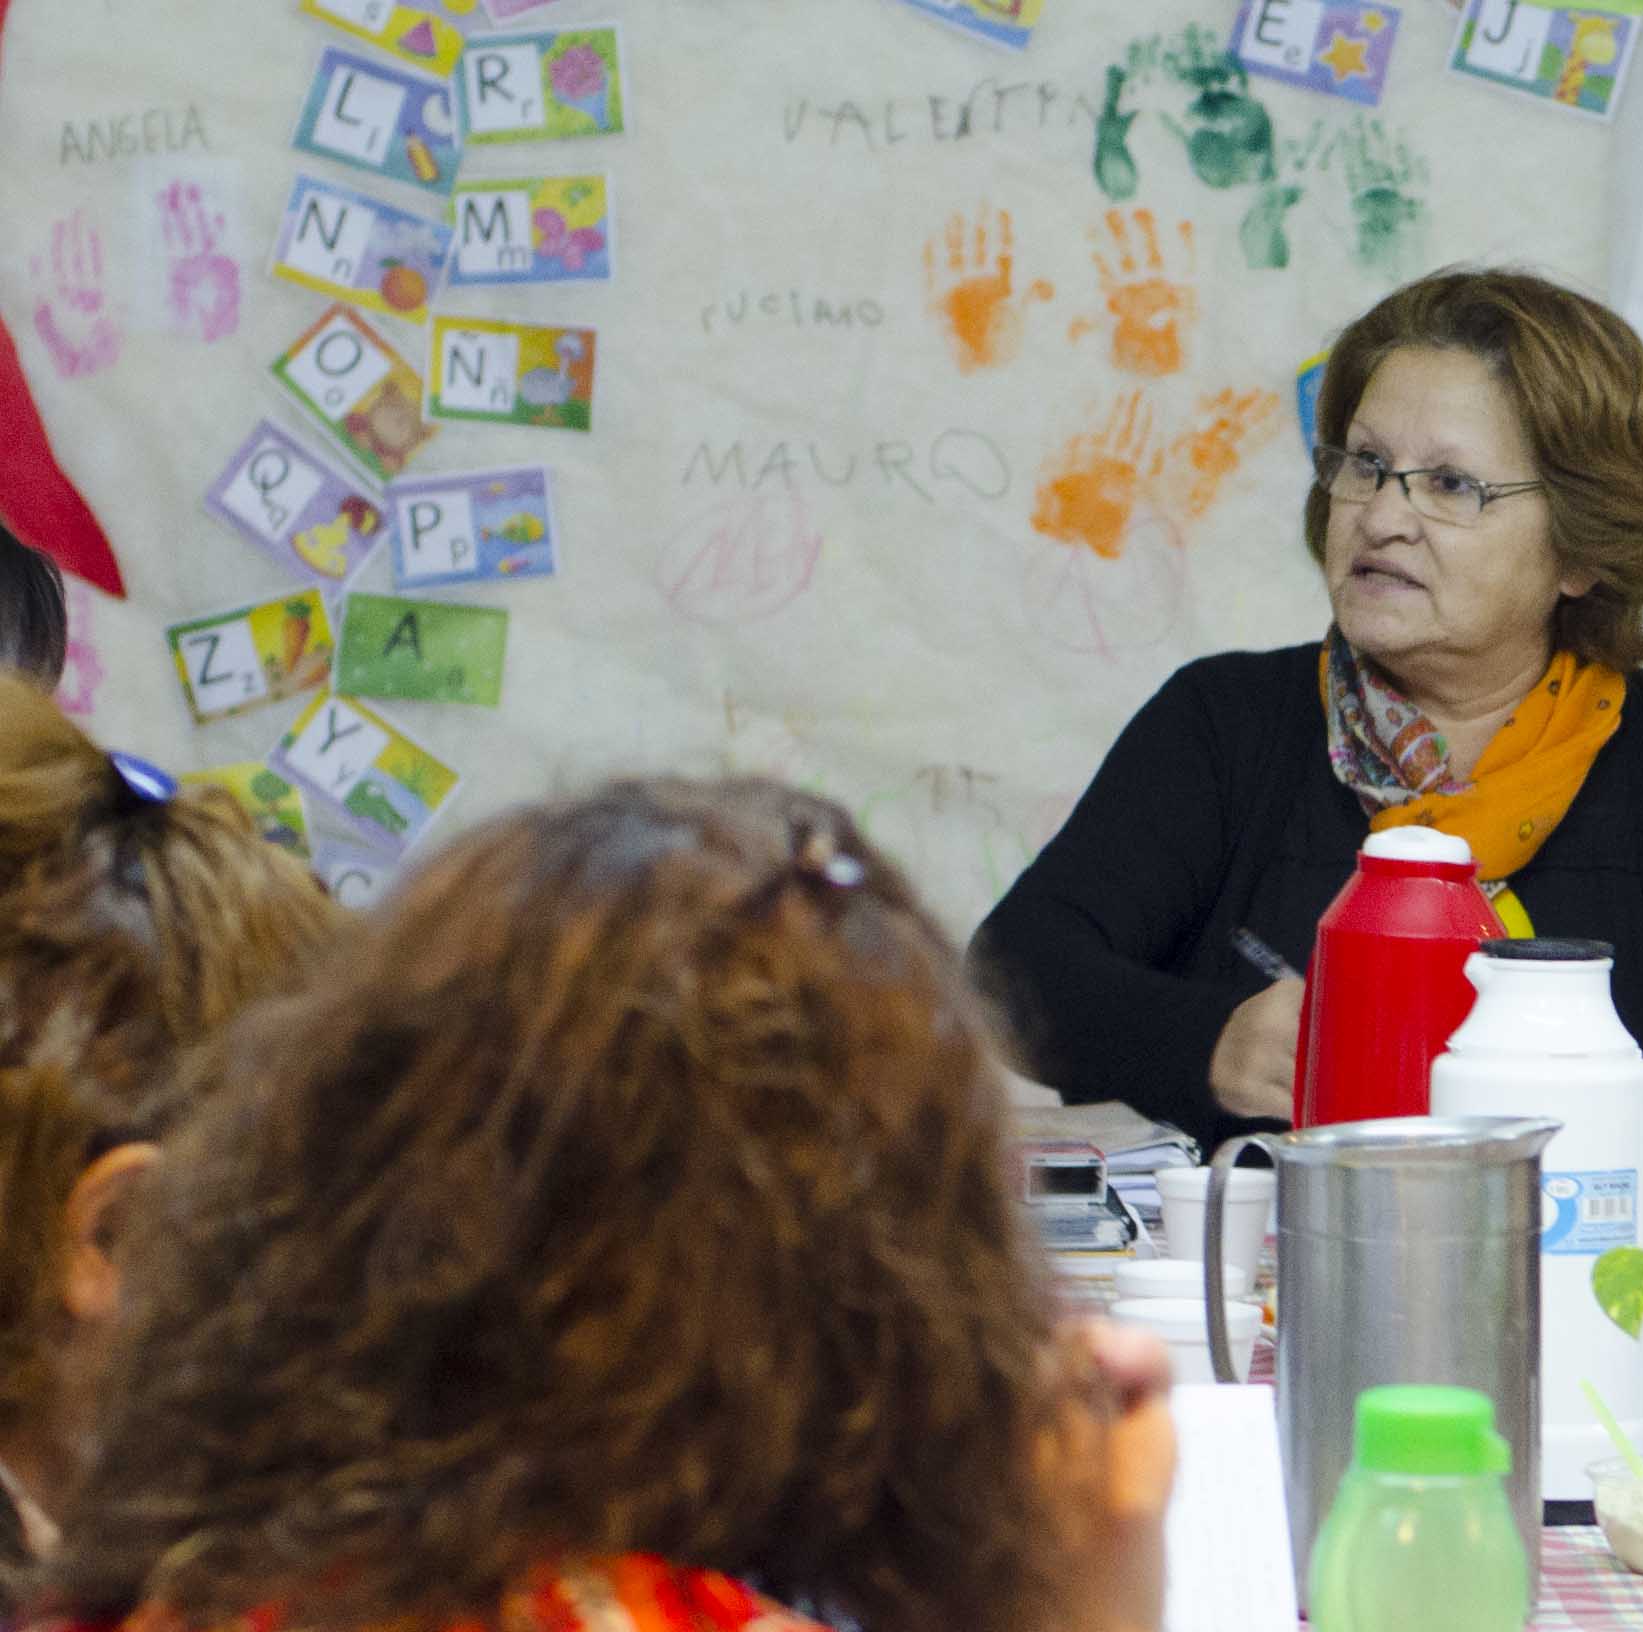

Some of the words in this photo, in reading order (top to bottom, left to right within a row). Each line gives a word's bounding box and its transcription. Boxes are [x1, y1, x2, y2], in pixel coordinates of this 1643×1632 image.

[336, 72, 362, 127] L
[476, 54, 515, 104] R
[297, 197, 350, 252] N
[462, 196, 513, 248] M
[314, 329, 364, 378] O
[676, 426, 1010, 504] MAURO
[408, 500, 441, 550] P
[188, 633, 233, 686] Z
[382, 608, 424, 661] A
[317, 705, 365, 756] Y
